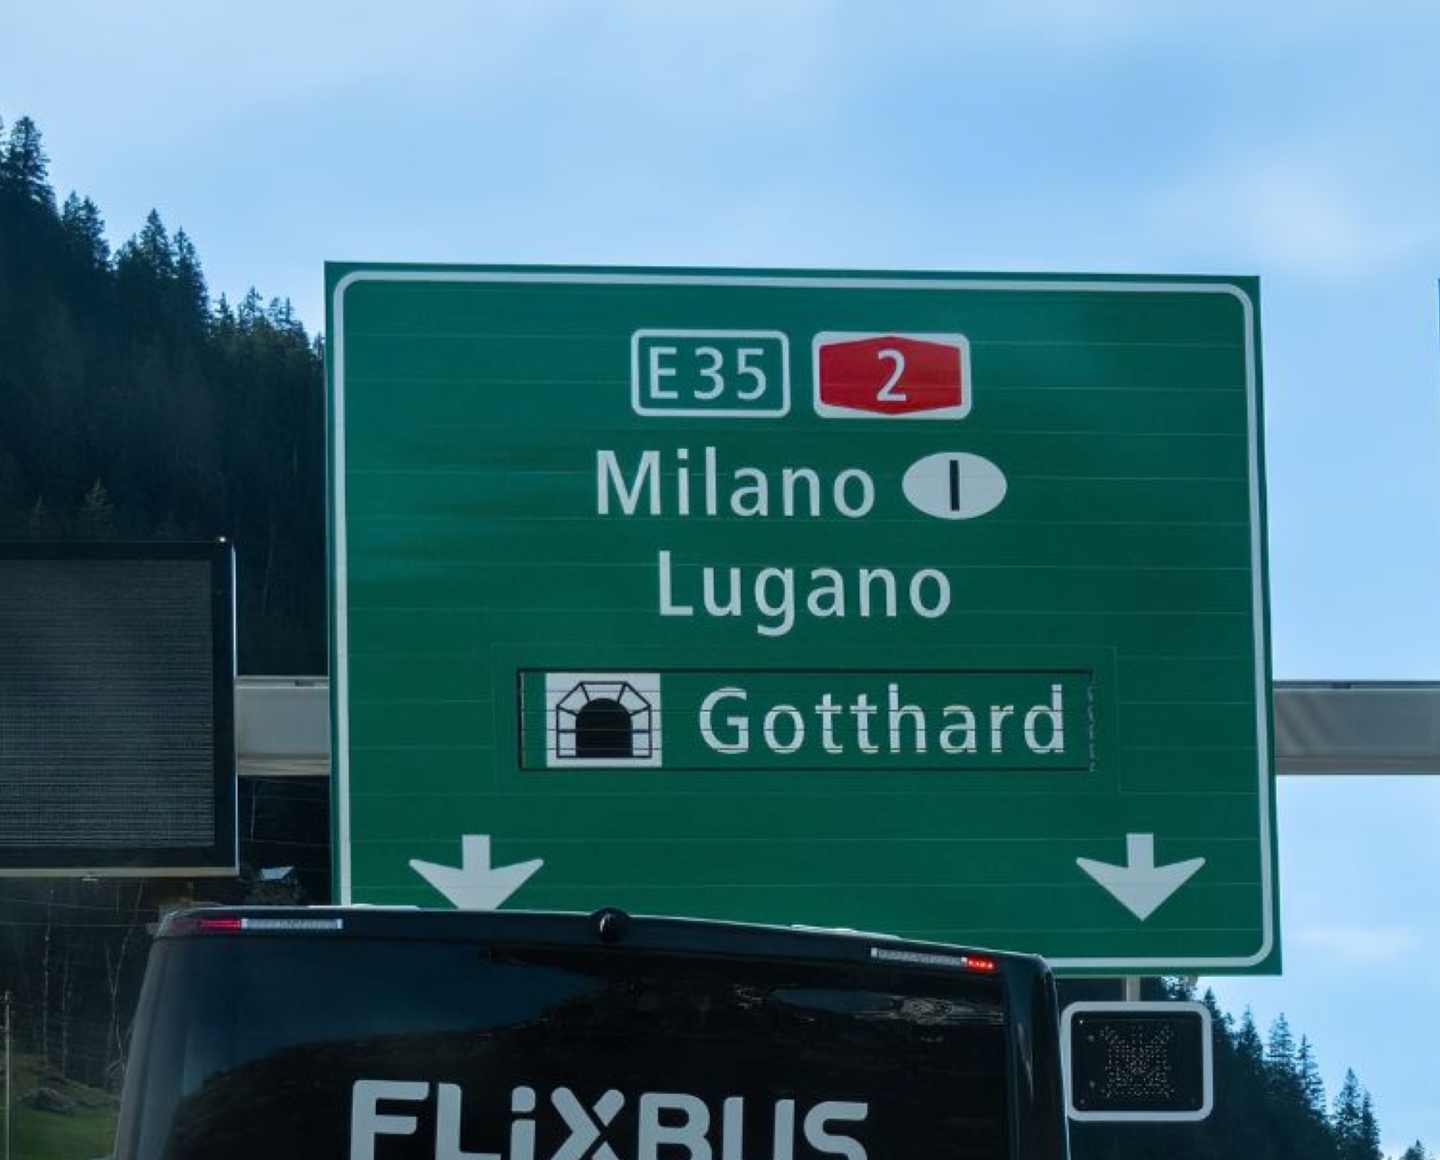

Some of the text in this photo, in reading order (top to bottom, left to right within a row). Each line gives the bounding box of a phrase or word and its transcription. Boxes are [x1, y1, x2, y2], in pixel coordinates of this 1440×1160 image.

[649, 345, 767, 401] E35
[876, 349, 907, 402] 2
[596, 446, 961, 518] Milano I
[658, 550, 952, 637] Lugano
[698, 683, 1066, 755] Gotthard
